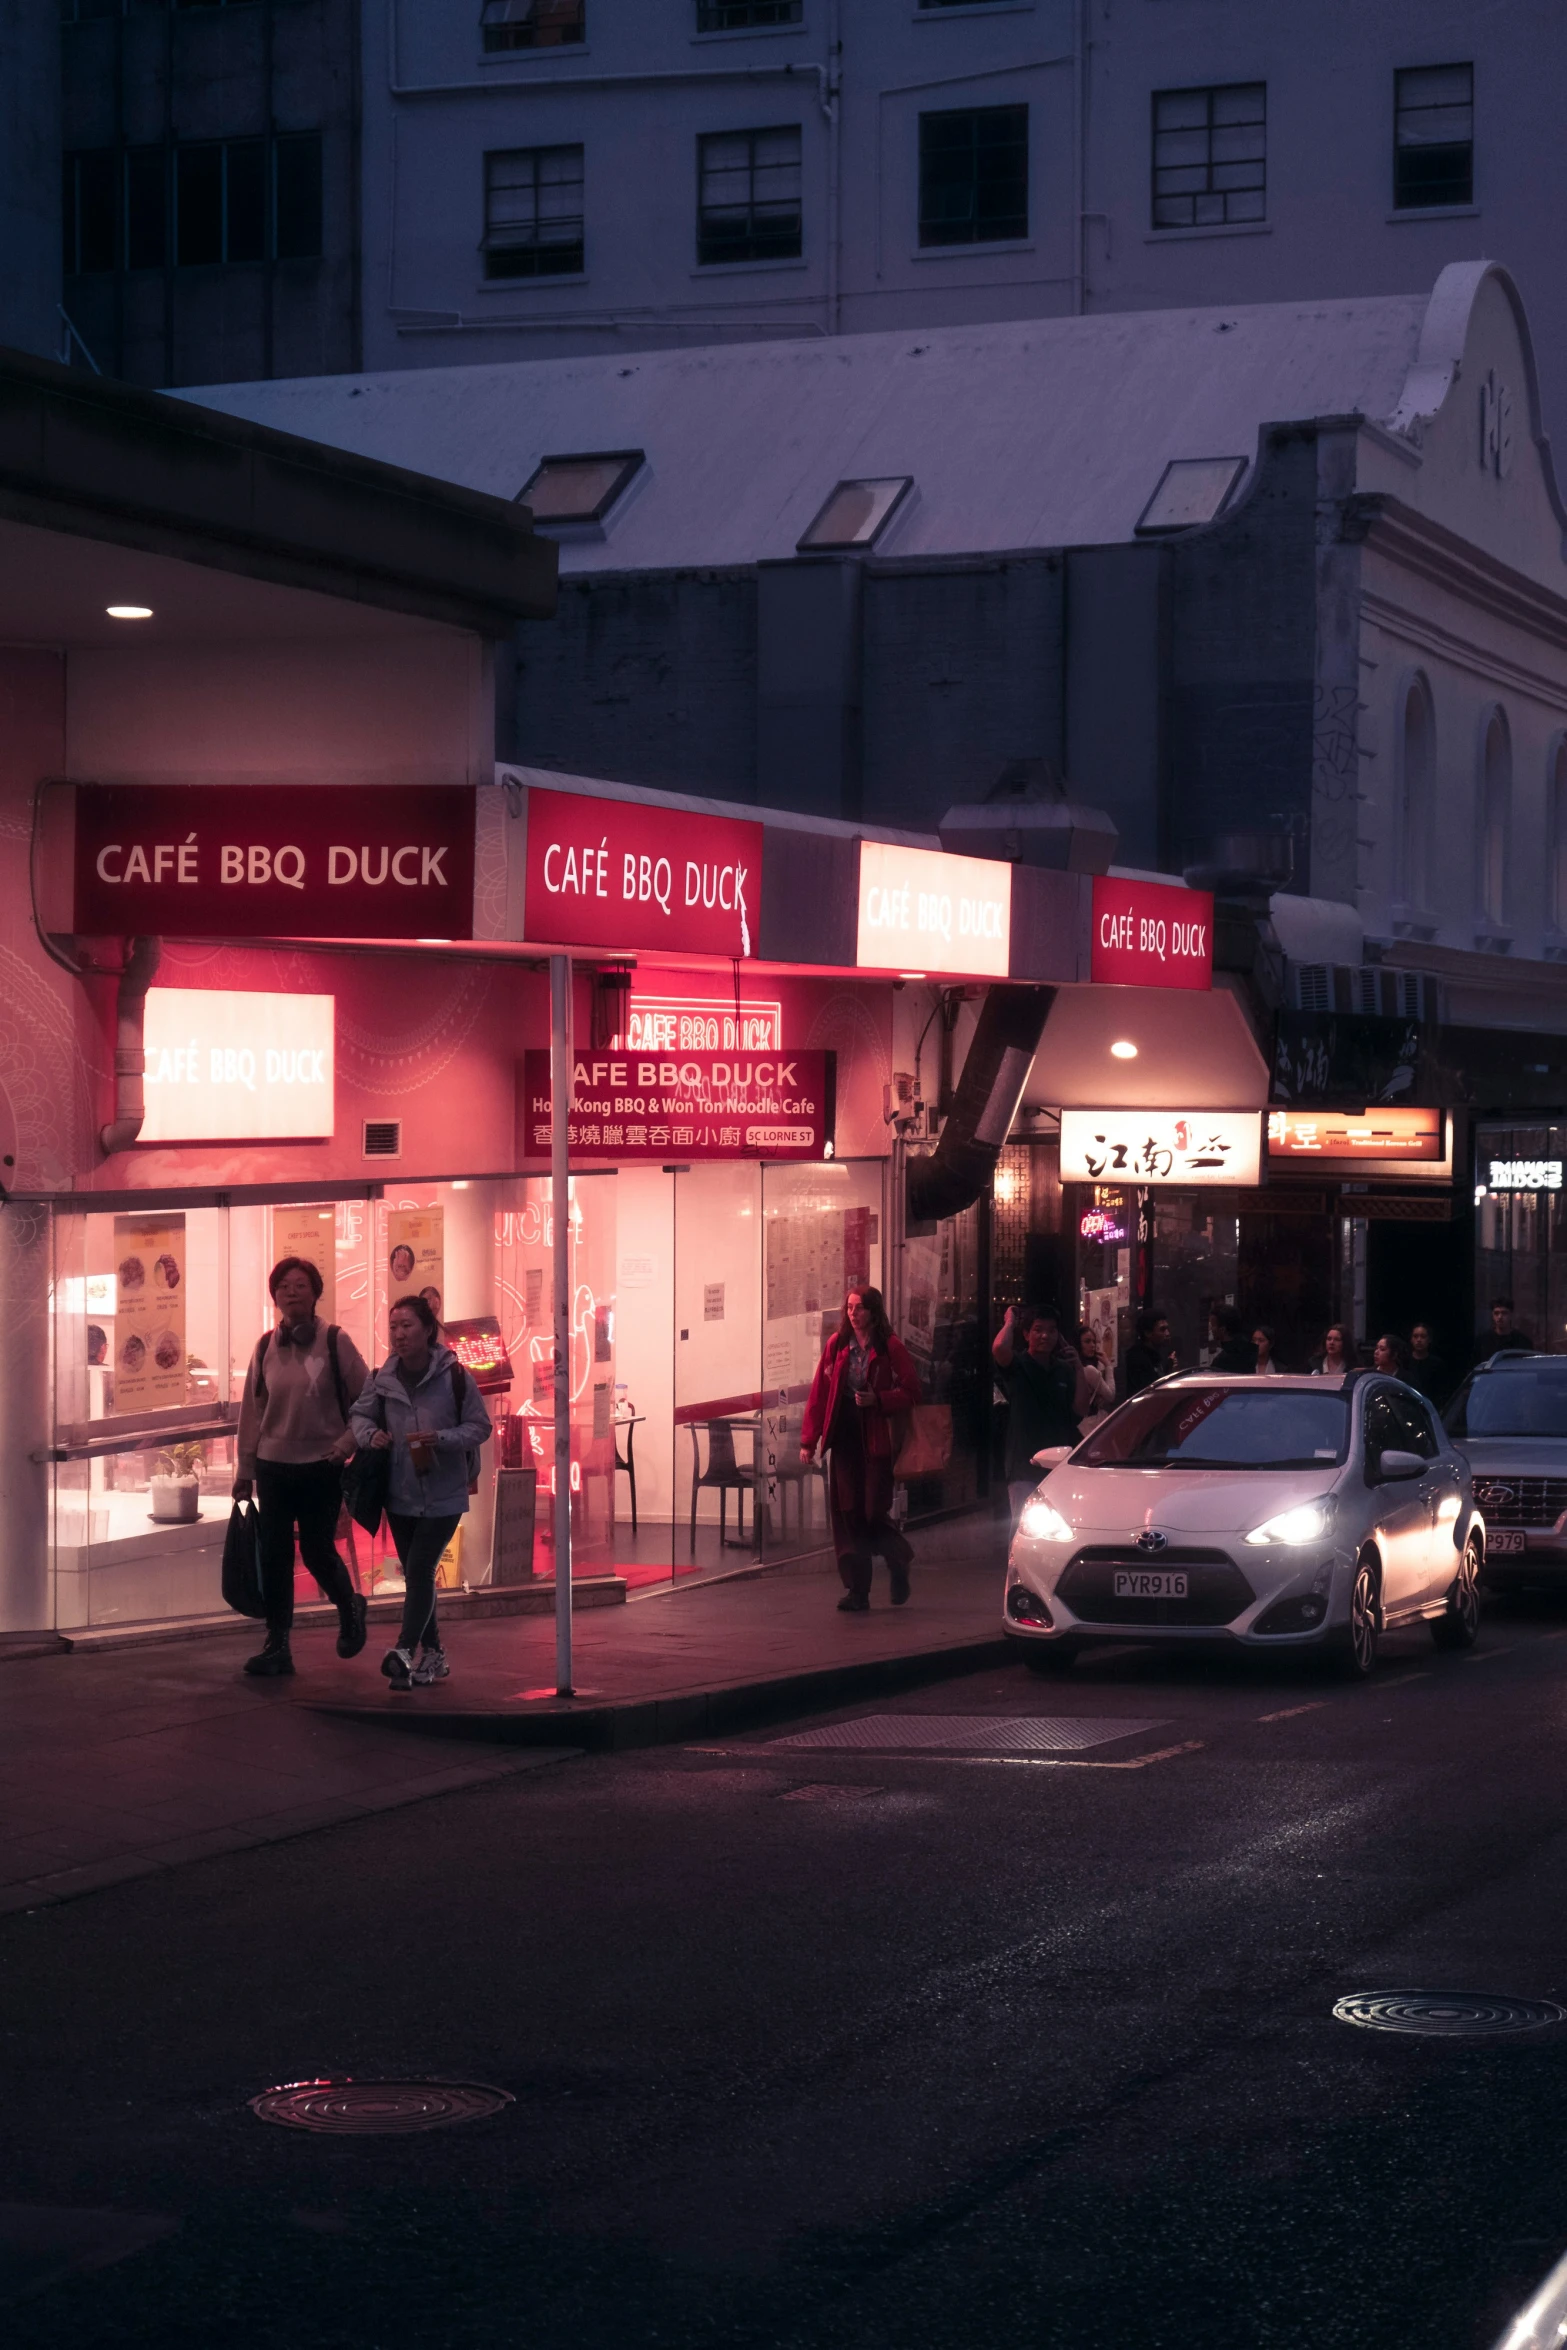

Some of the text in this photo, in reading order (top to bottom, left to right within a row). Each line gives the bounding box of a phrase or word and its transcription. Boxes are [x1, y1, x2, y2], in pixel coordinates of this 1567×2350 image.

[96, 832, 448, 889] CAFÉ BBQ DUCK
[543, 837, 747, 915] CAFÉ BBQ DUCK
[866, 877, 1003, 944] CAFÉ BBQ DUCK
[1100, 907, 1205, 961] CAFÉ BBQ DUCK
[628, 1013, 677, 1050] CAFE
[143, 1038, 325, 1091] CAFÉ BBQ DUCK
[573, 1063, 797, 1087] AFE BBQ DUCK
[533, 1097, 815, 1117] Ho Kong BBQ & Won Ton Noodle Cafe
[748, 1131, 812, 1142] 5C LORNE ST
[1081, 1214, 1105, 1236] OPEN
[1117, 1573, 1185, 1596] PYR916
